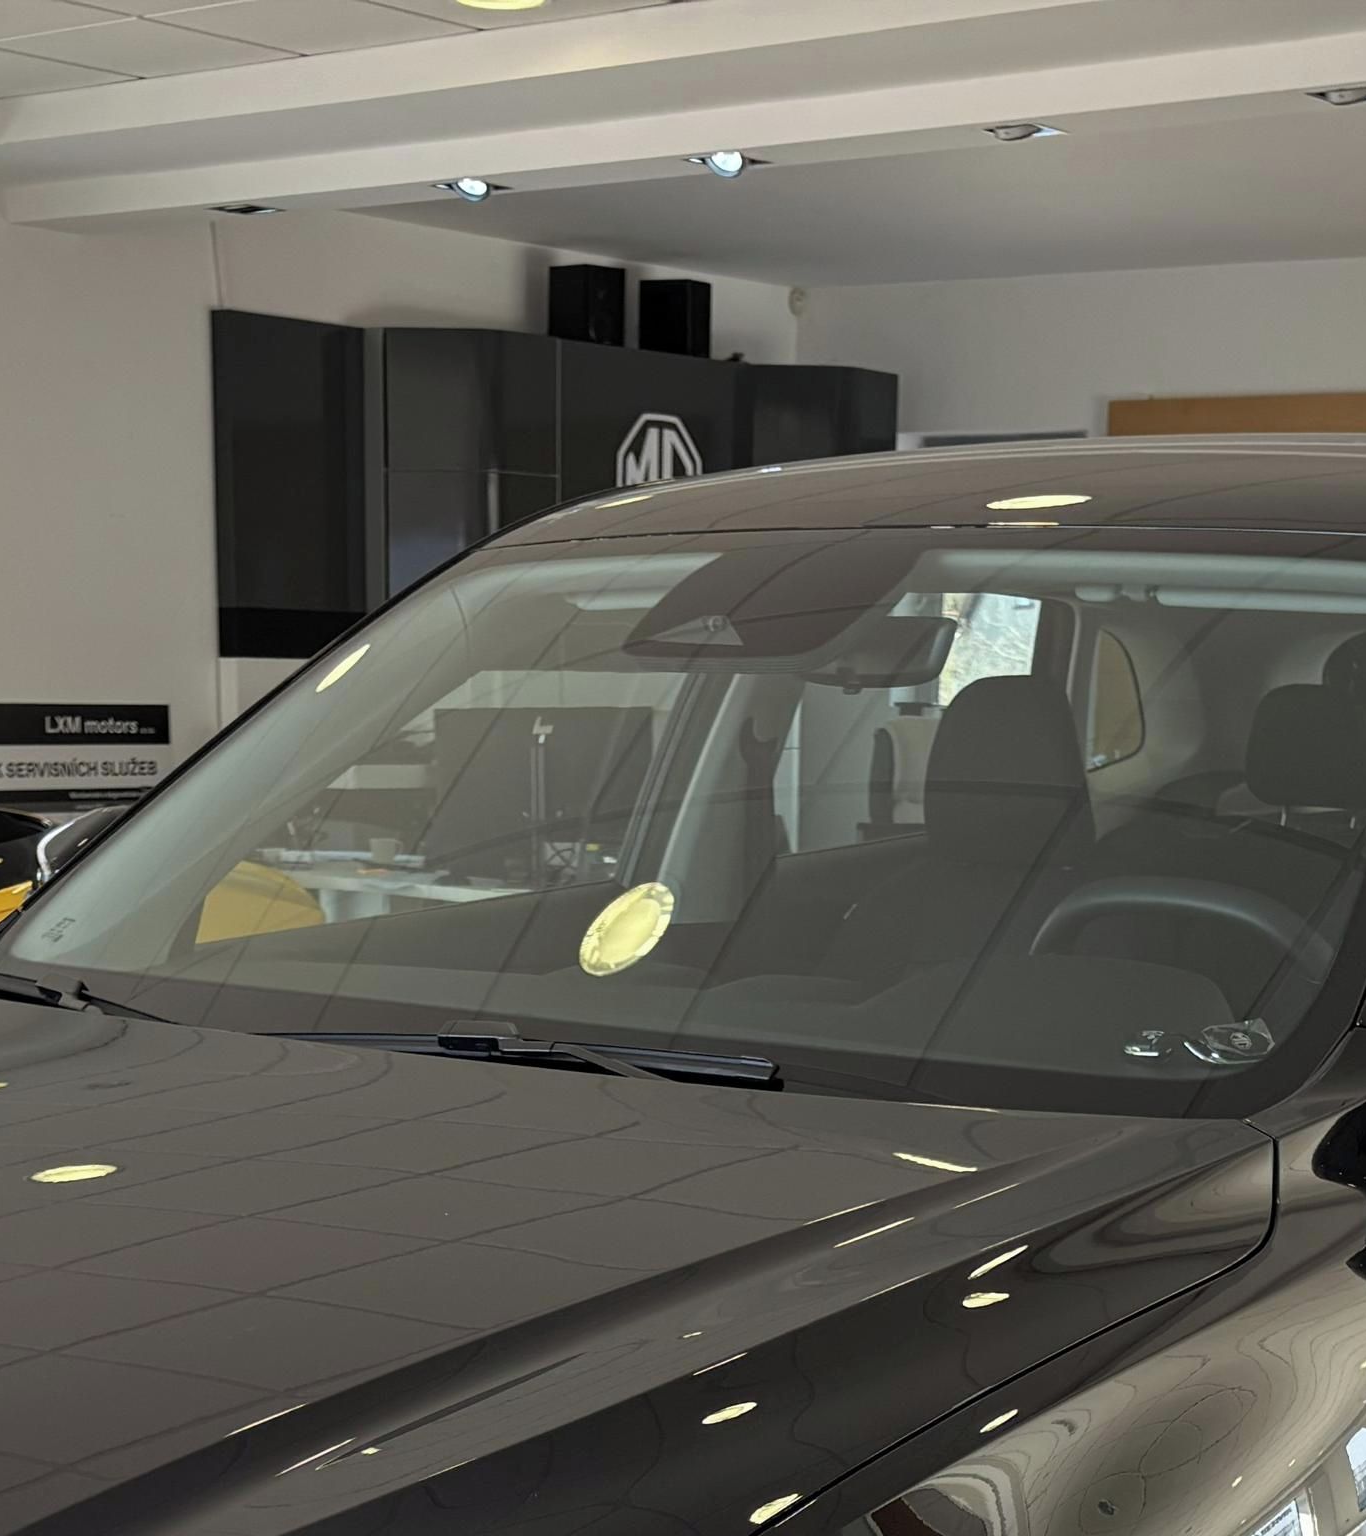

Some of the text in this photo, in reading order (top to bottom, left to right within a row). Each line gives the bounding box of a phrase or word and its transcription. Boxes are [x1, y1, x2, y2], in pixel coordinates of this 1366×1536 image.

[44, 716, 82, 734] LXM
[83, 717, 139, 734] motors
[5, 758, 98, 778] SERVISNÍCH
[100, 757, 157, 776] SLUŽEB
